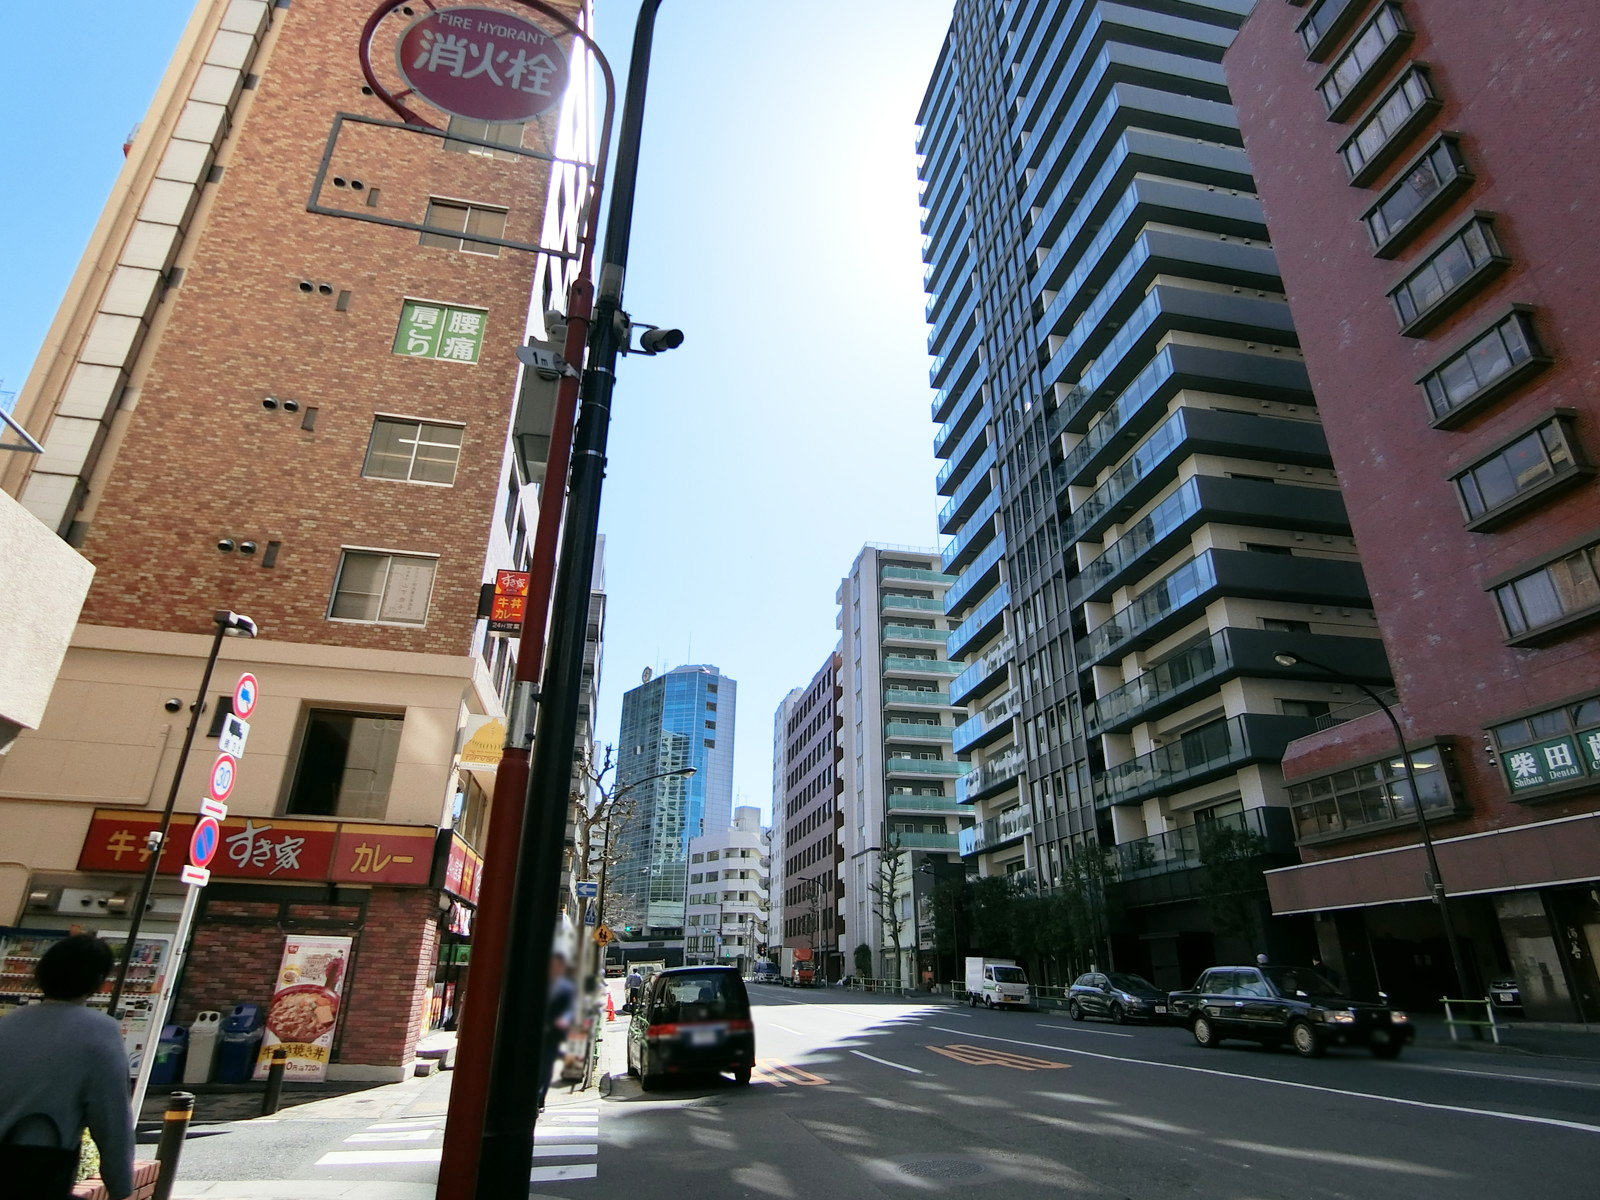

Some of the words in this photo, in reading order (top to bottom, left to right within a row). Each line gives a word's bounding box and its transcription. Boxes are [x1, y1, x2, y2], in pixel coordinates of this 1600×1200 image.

[438, 12, 472, 31] FIRE
[477, 20, 548, 46] HYDRANT
[413, 28, 558, 97] 消火栓
[406, 305, 440, 356] 肩こり
[443, 311, 481, 360] 腰痛
[501, 573, 526, 589] すき家
[495, 608, 521, 619] カレー
[497, 597, 522, 609] 牛丼
[216, 767, 231, 789] 30
[1513, 775, 1544, 788] Shibata
[1548, 765, 1579, 780] Dental
[225, 819, 305, 875] すき家
[350, 842, 414, 873] カレー
[262, 1044, 325, 1060] 牛き焼き丼
